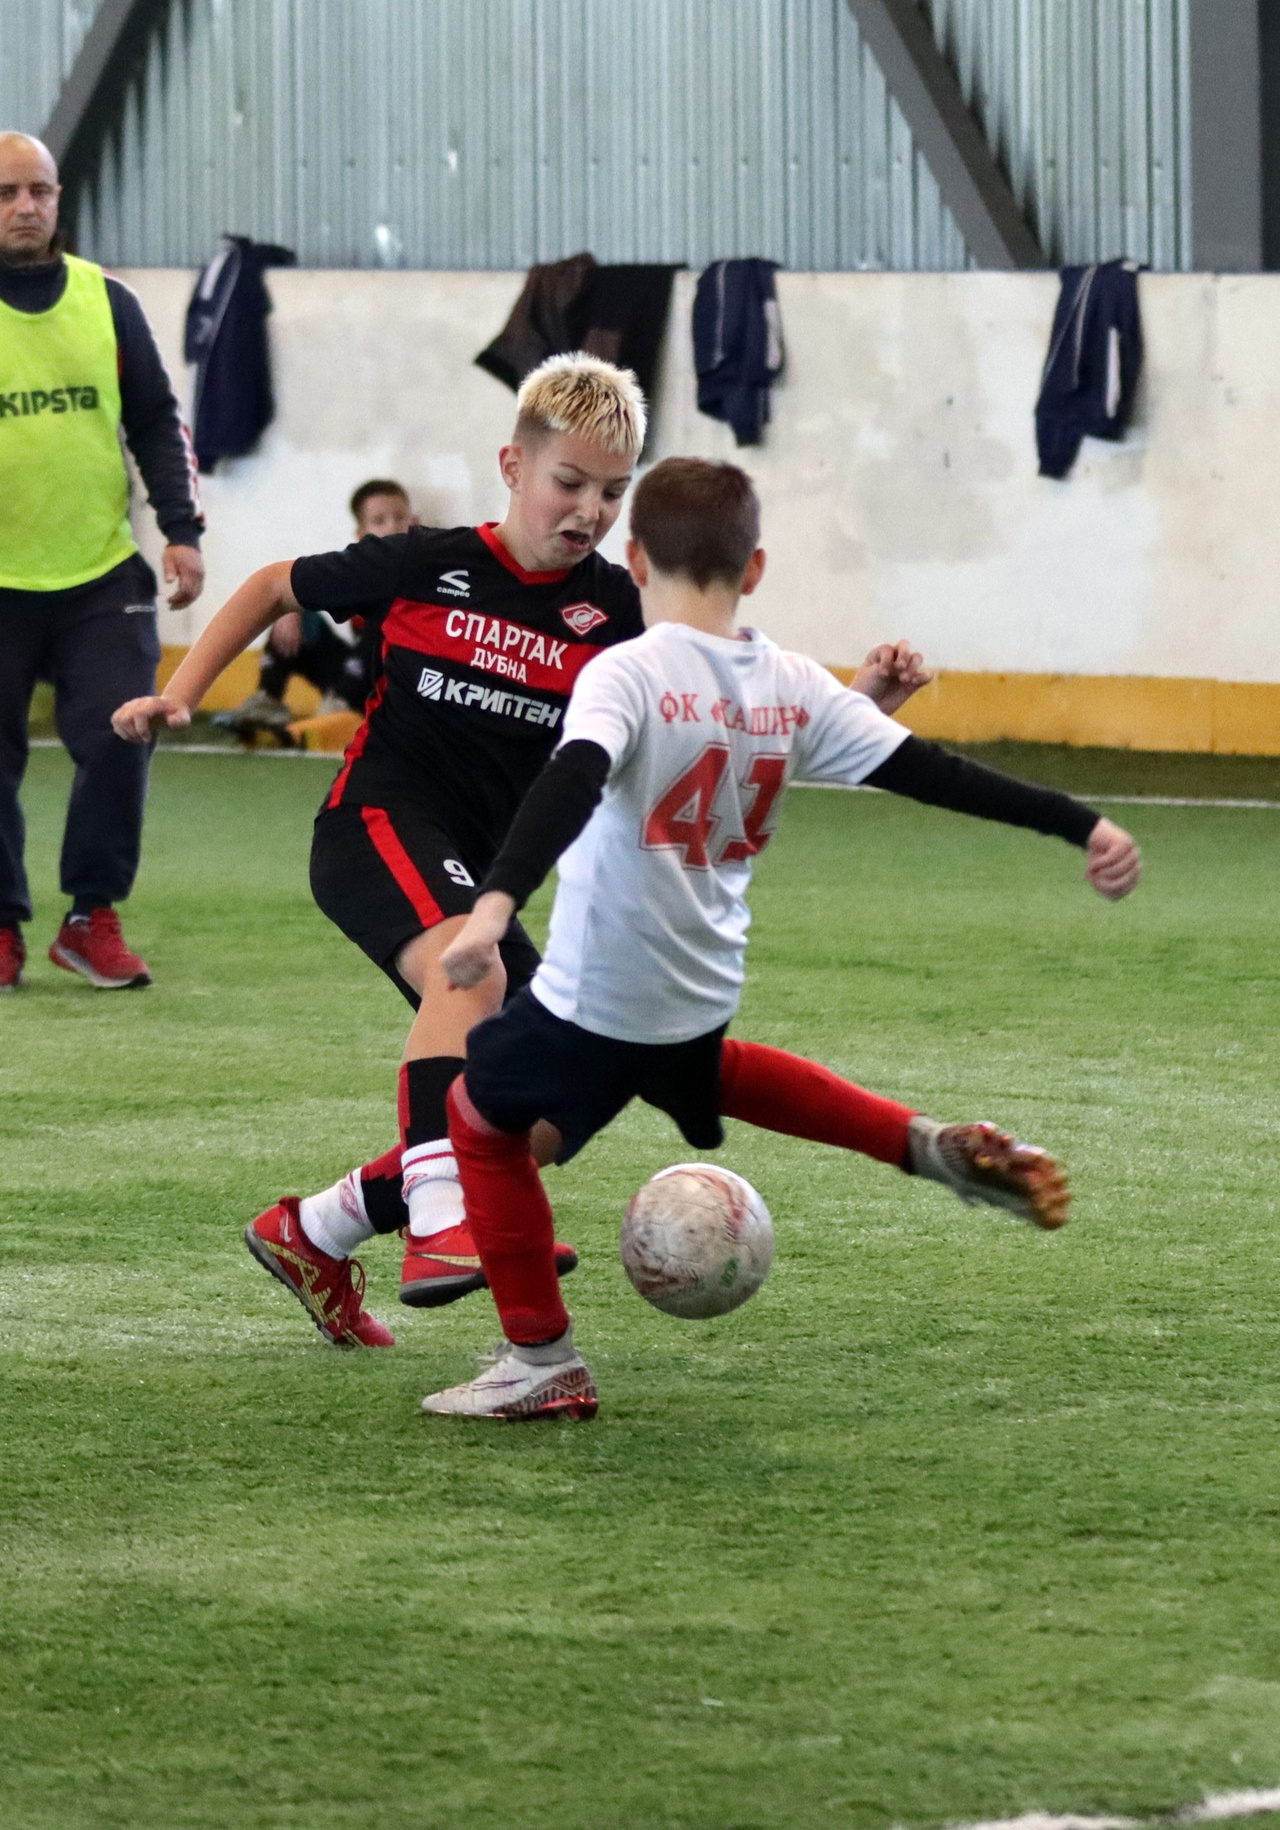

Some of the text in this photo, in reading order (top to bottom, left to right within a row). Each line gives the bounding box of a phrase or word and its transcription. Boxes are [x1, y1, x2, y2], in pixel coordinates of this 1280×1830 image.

[436, 586, 470, 598] campeo
[445, 609, 569, 670] СПАРТАК
[470, 647, 528, 684] ДУБНА
[444, 677, 563, 729] КРИПТЕН
[659, 691, 701, 724] ФК
[442, 858, 476, 888] 9
